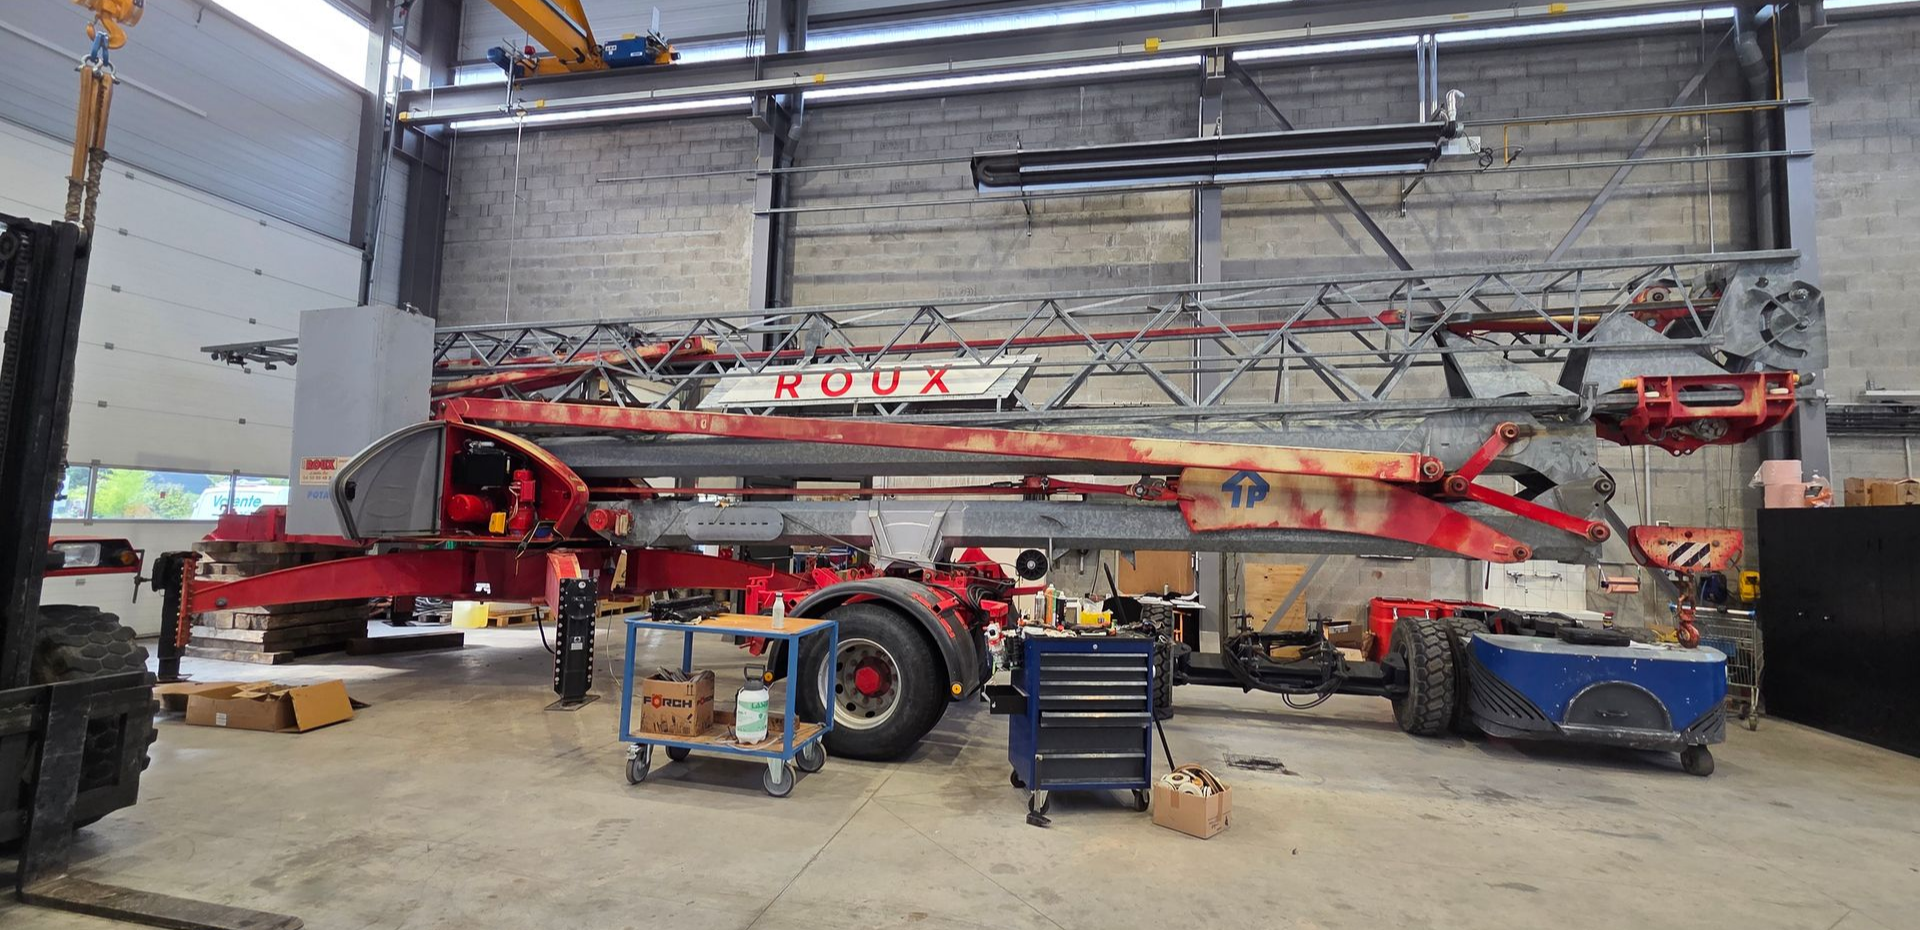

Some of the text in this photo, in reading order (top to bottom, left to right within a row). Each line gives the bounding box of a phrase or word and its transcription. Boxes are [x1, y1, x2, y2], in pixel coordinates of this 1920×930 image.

[774, 364, 952, 399] ROUX
[306, 459, 336, 470] ROUX
[307, 491, 329, 499] POTA
[213, 495, 262, 507] Vente
